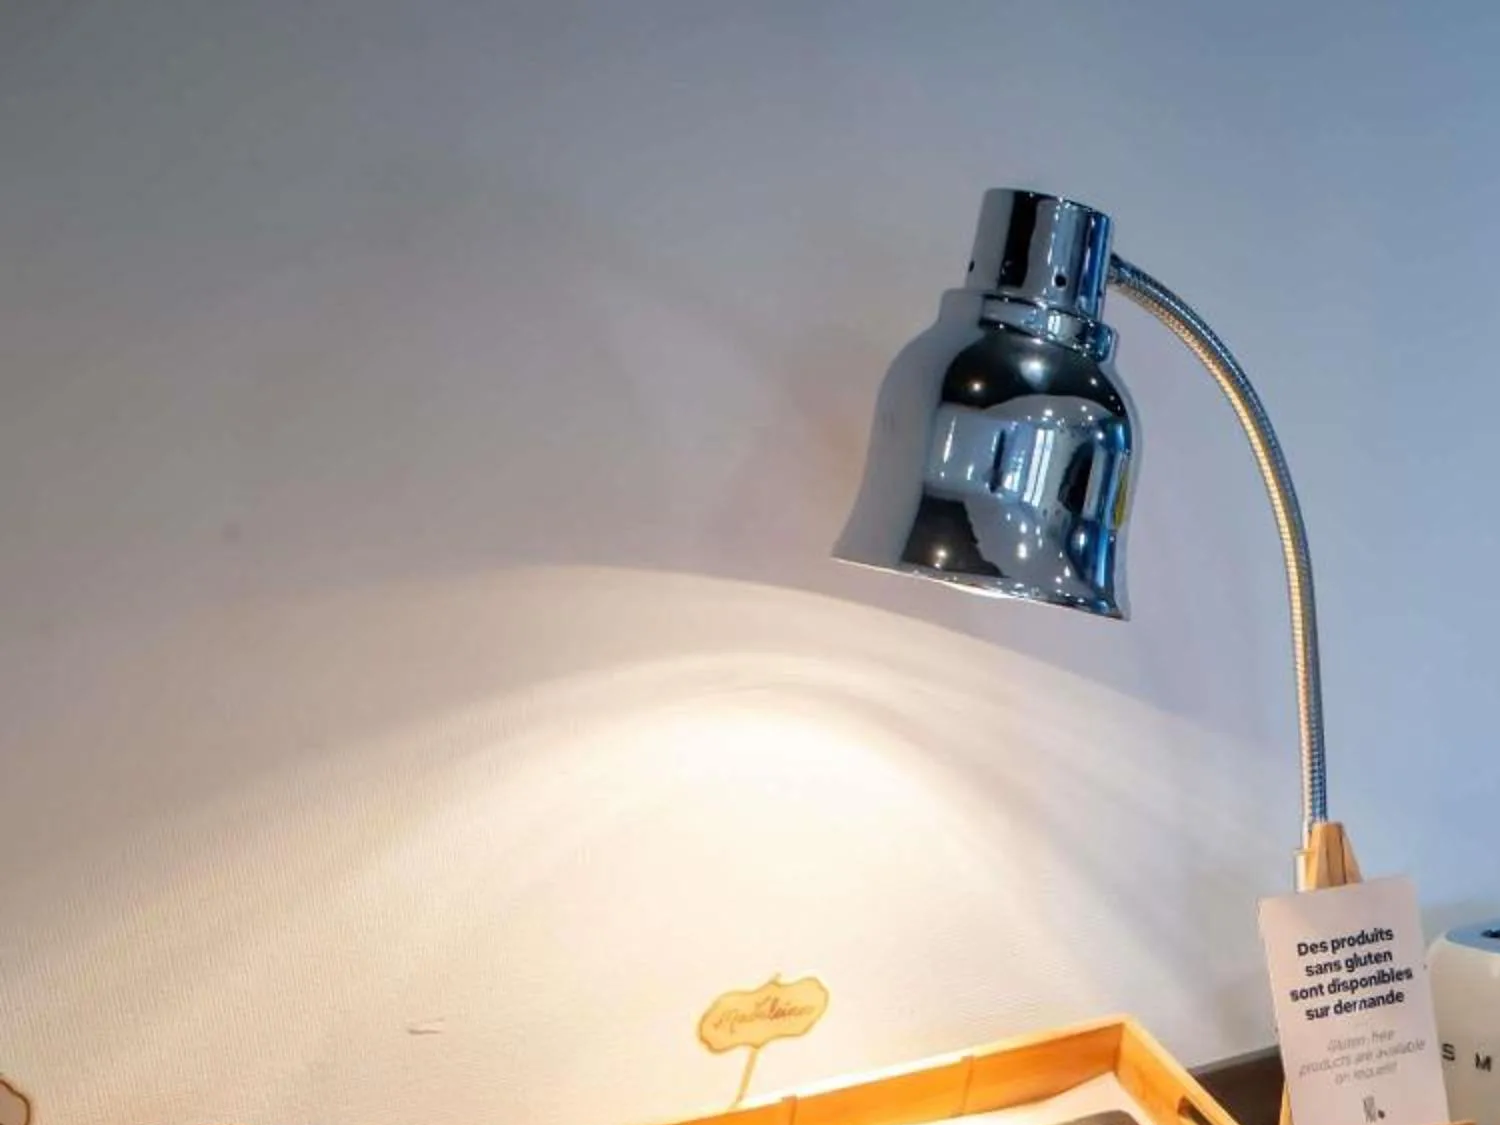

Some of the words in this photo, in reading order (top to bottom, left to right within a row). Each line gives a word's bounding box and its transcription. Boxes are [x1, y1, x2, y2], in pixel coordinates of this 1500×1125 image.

[1297, 941, 1329, 956] Des
[1331, 927, 1394, 953] produits
[1305, 957, 1342, 977] sans
[1344, 950, 1393, 973] gluten
[1290, 983, 1325, 1002] sont
[1327, 966, 1414, 995] disponibles
[1305, 1004, 1331, 1021] sur
[1333, 989, 1405, 1014] demande
